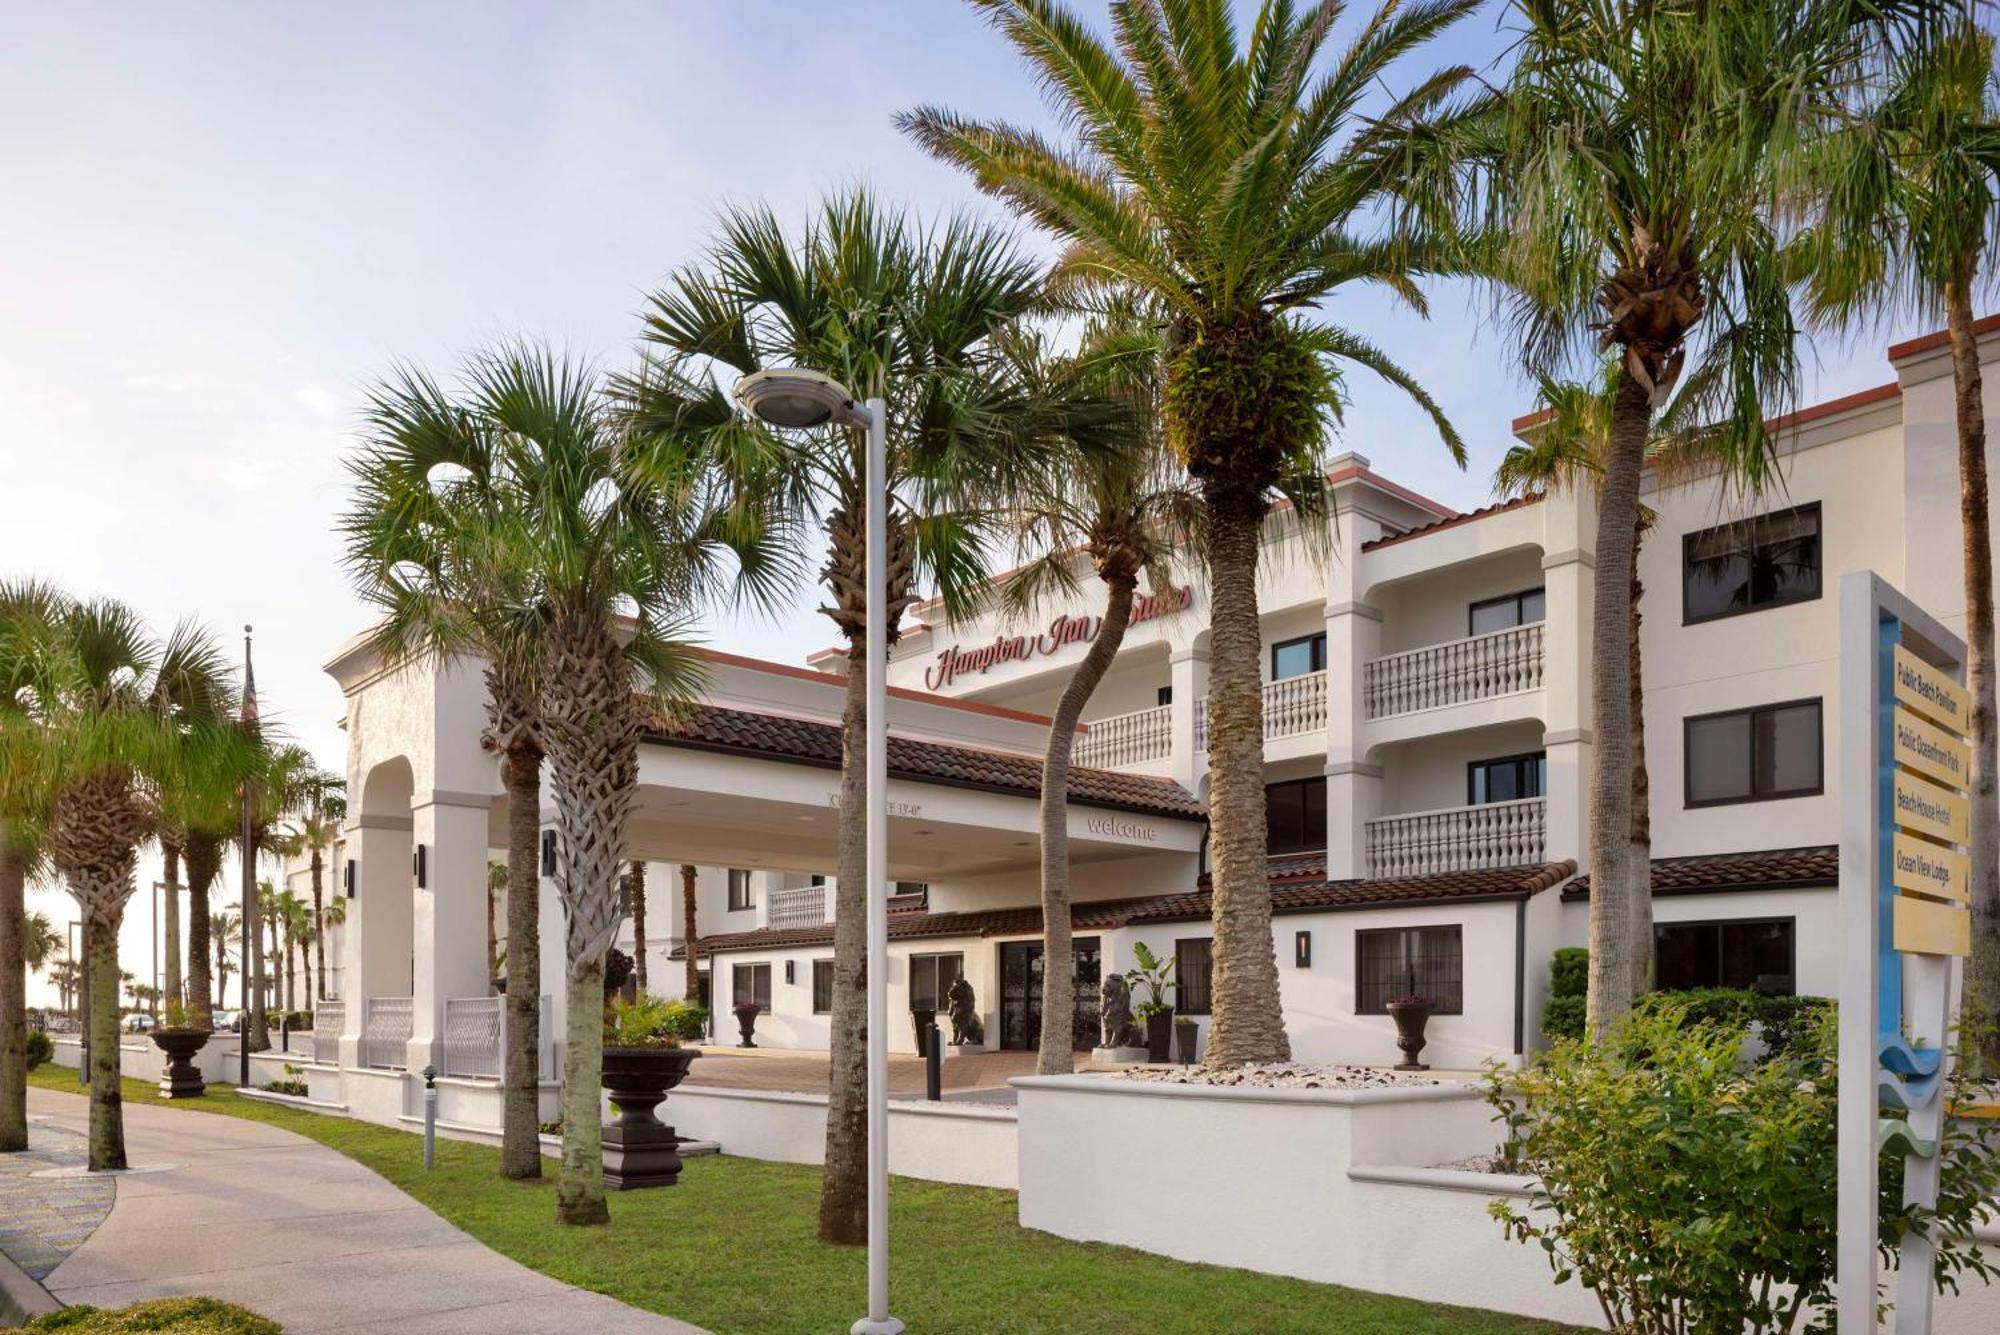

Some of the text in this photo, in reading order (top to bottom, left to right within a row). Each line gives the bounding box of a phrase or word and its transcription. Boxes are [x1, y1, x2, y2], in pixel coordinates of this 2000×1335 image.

[926, 636, 1036, 690] Hampton
[1037, 613, 1101, 656] Inn
[1898, 662, 1917, 693] Public
[1918, 673, 1936, 704] Beach
[1898, 724, 1917, 752] Public
[1897, 787, 1952, 826] Beach House Hotel
[1087, 816, 1158, 841] welcome
[1897, 849, 1950, 887] Ocean View Lodge
